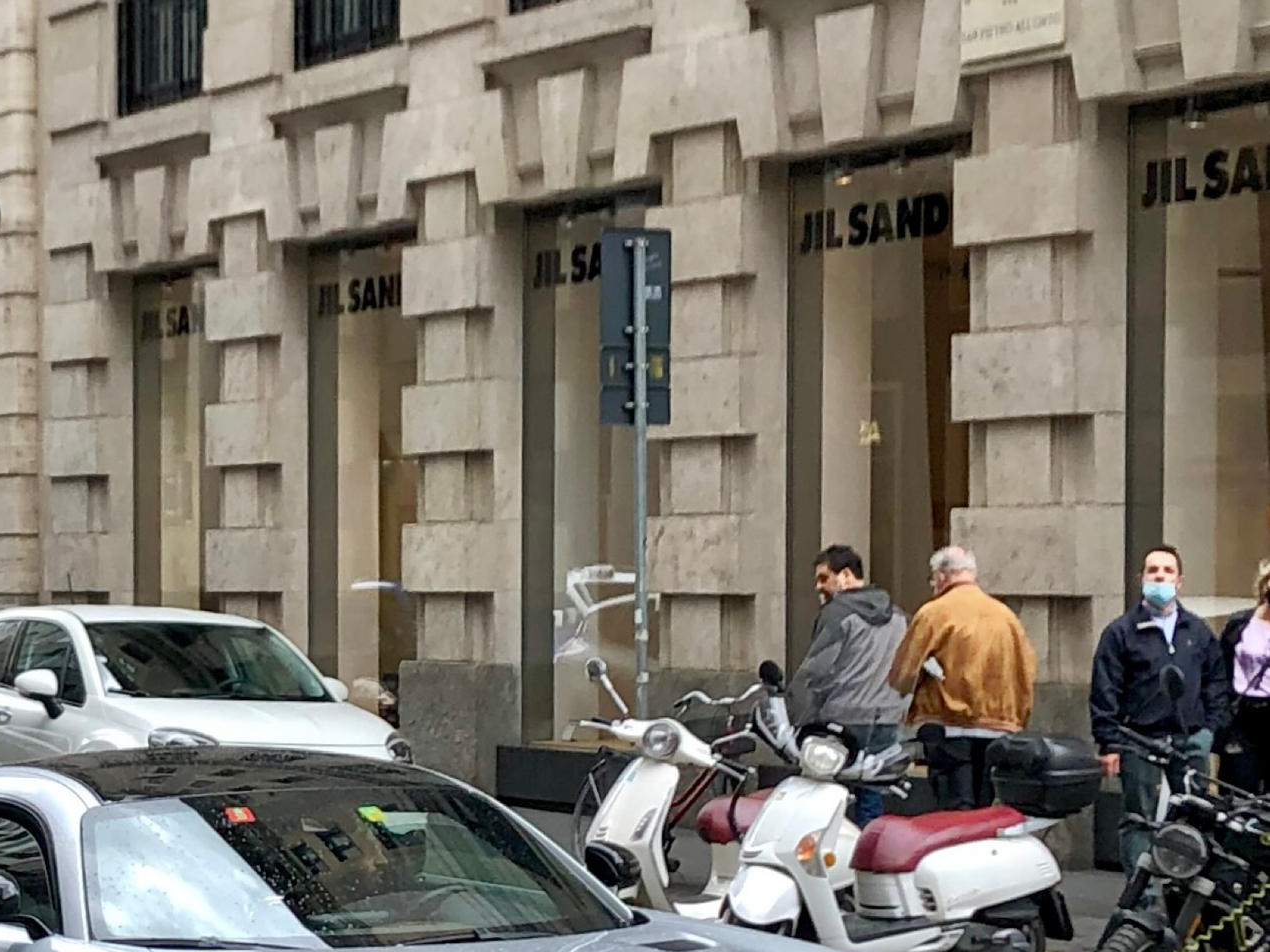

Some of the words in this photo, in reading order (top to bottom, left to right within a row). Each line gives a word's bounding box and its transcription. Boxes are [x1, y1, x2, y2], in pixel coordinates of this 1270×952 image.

[1141, 158, 1197, 208] JIL
[1203, 145, 1270, 199] SA
[800, 208, 843, 254] JIL
[848, 193, 949, 246] SAND
